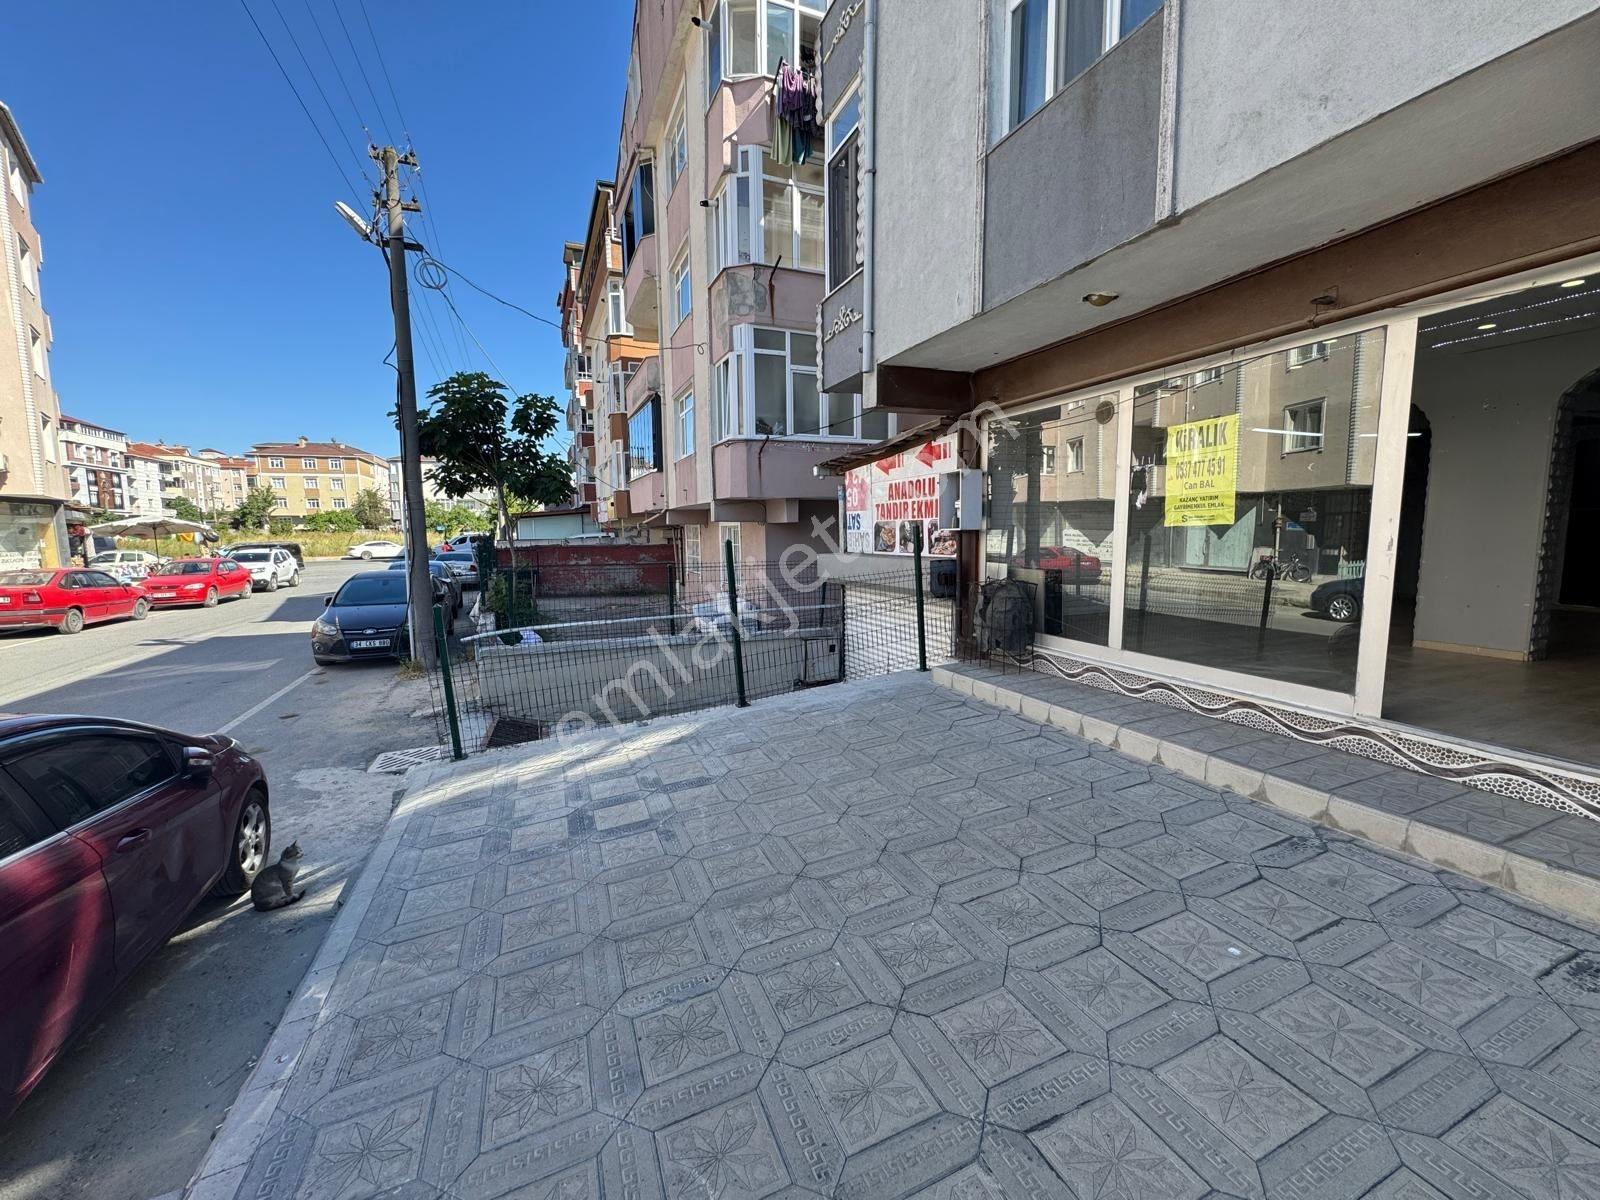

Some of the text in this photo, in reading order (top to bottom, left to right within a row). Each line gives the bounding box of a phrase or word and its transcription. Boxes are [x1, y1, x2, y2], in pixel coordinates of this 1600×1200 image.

[888, 476, 936, 501] ANADOLU
[1183, 479, 1215, 490] Can BAL
[875, 501, 909, 521] TANDIR
